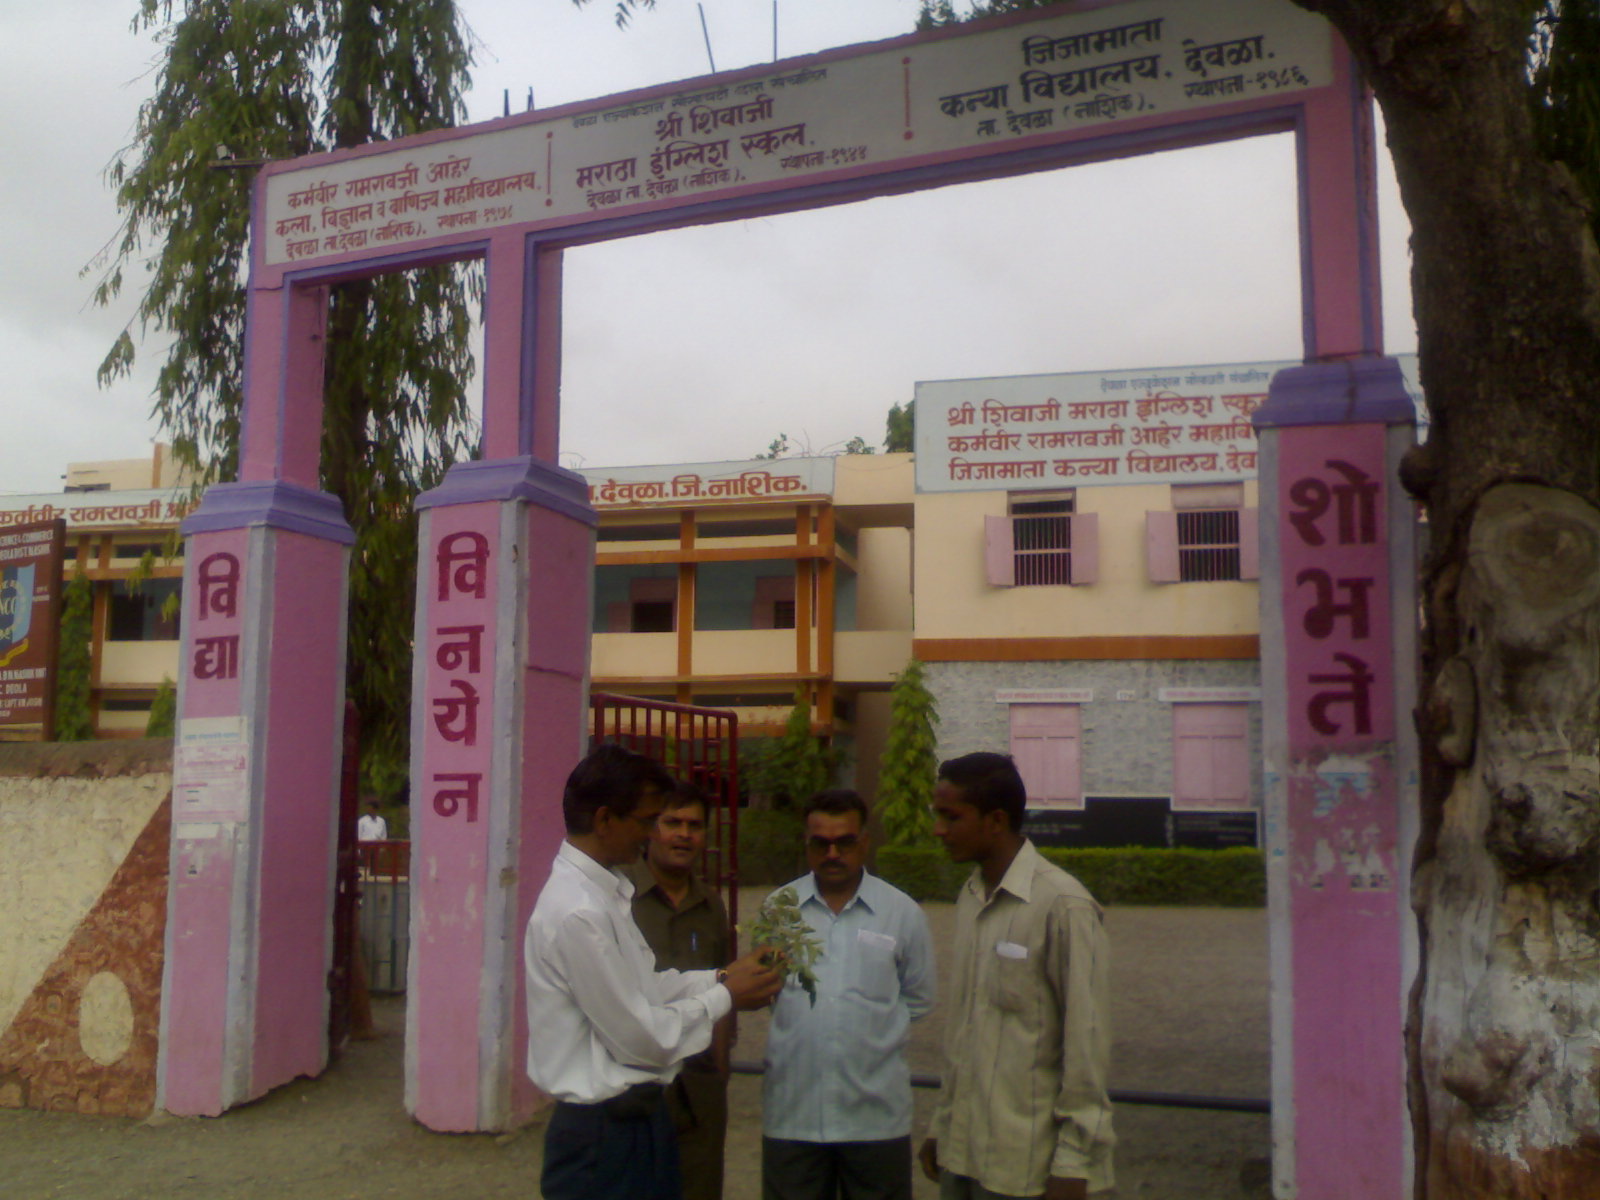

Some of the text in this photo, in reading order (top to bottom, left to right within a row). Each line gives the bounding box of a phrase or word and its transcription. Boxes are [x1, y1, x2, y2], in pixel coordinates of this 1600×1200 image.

[1022, 18, 1164, 67] जिजामाता
[656, 94, 774, 142] श्री शिवाजी
[939, 84, 1008, 118] कन्या
[288, 155, 472, 210] कर्मवीर रामरावजी आहेर
[577, 157, 637, 188] मराठा
[650, 139, 729, 179] इंग्लिश
[322, 202, 373, 231] विज्ञान
[377, 201, 386, 218] व
[947, 402, 975, 427] श्री
[981, 398, 1062, 428] शिवाजी
[1068, 400, 1129, 421] मराठा
[1135, 390, 1214, 418] इंग्लिश
[947, 415, 1254, 454] कर्मवीर रामरावजी आहेर महावि
[949, 457, 1047, 481] जिजामाता
[1053, 457, 1120, 478] कन्या
[70, 499, 163, 523] रामरावजी
